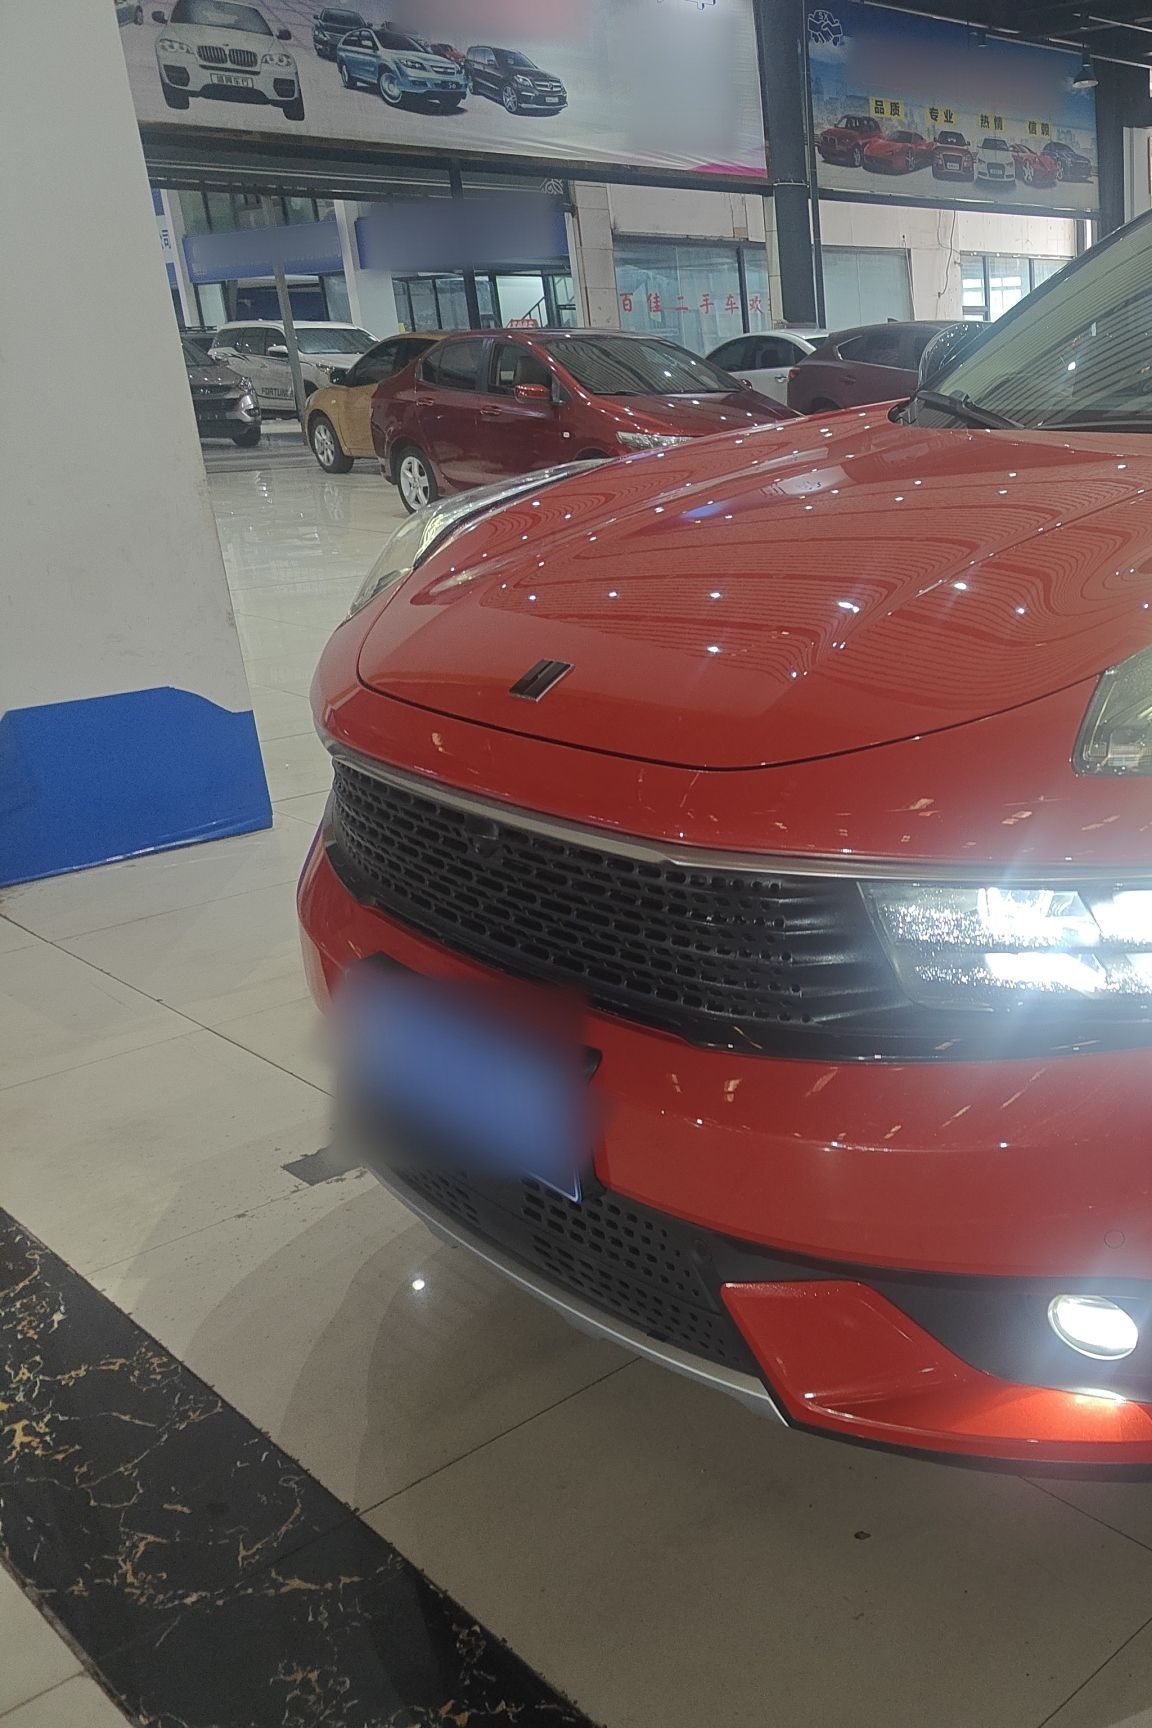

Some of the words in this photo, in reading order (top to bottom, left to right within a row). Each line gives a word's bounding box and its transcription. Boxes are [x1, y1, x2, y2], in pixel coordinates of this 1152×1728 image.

[874, 99, 901, 116] 品质
[928, 106, 955, 124] 专业
[980, 113, 1004, 131] 热情
[1028, 120, 1050, 137] 信赖
[620, 292, 771, 315] 百佳二手车欢
